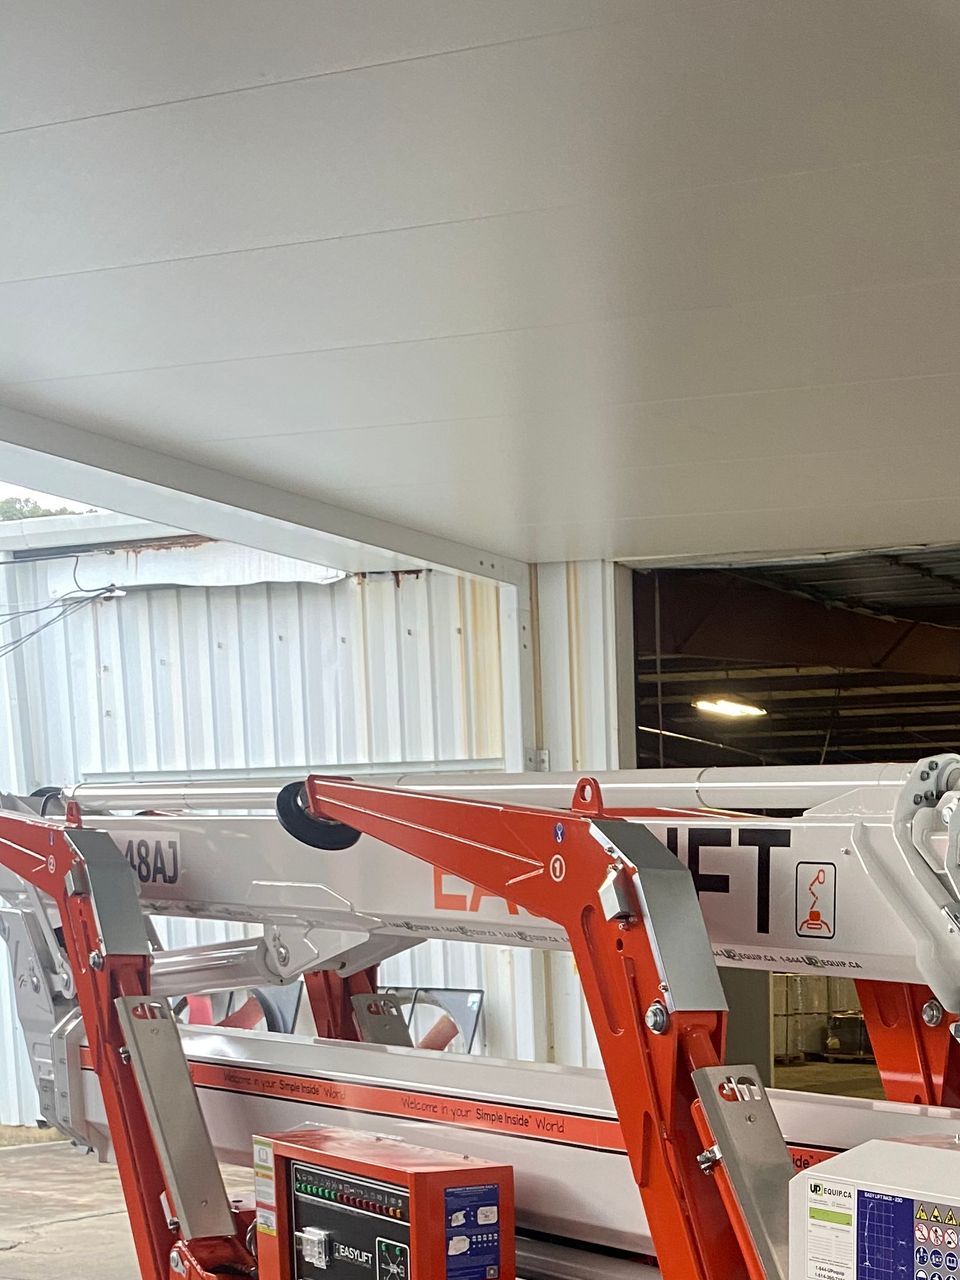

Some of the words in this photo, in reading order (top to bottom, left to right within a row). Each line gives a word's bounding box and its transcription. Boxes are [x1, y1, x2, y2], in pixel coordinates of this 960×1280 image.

[667, 827, 791, 934] FT
[822, 960, 863, 969] EQUIP.CA
[401, 1097, 438, 1113] Welcome
[451, 1107, 472, 1120] your
[476, 1108, 503, 1125] Simple
[535, 1118, 565, 1133] World
[810, 1183, 822, 1194] UP
[824, 1187, 852, 1198] EQUIP.CA
[340, 1244, 372, 1265] EASYLIFT
